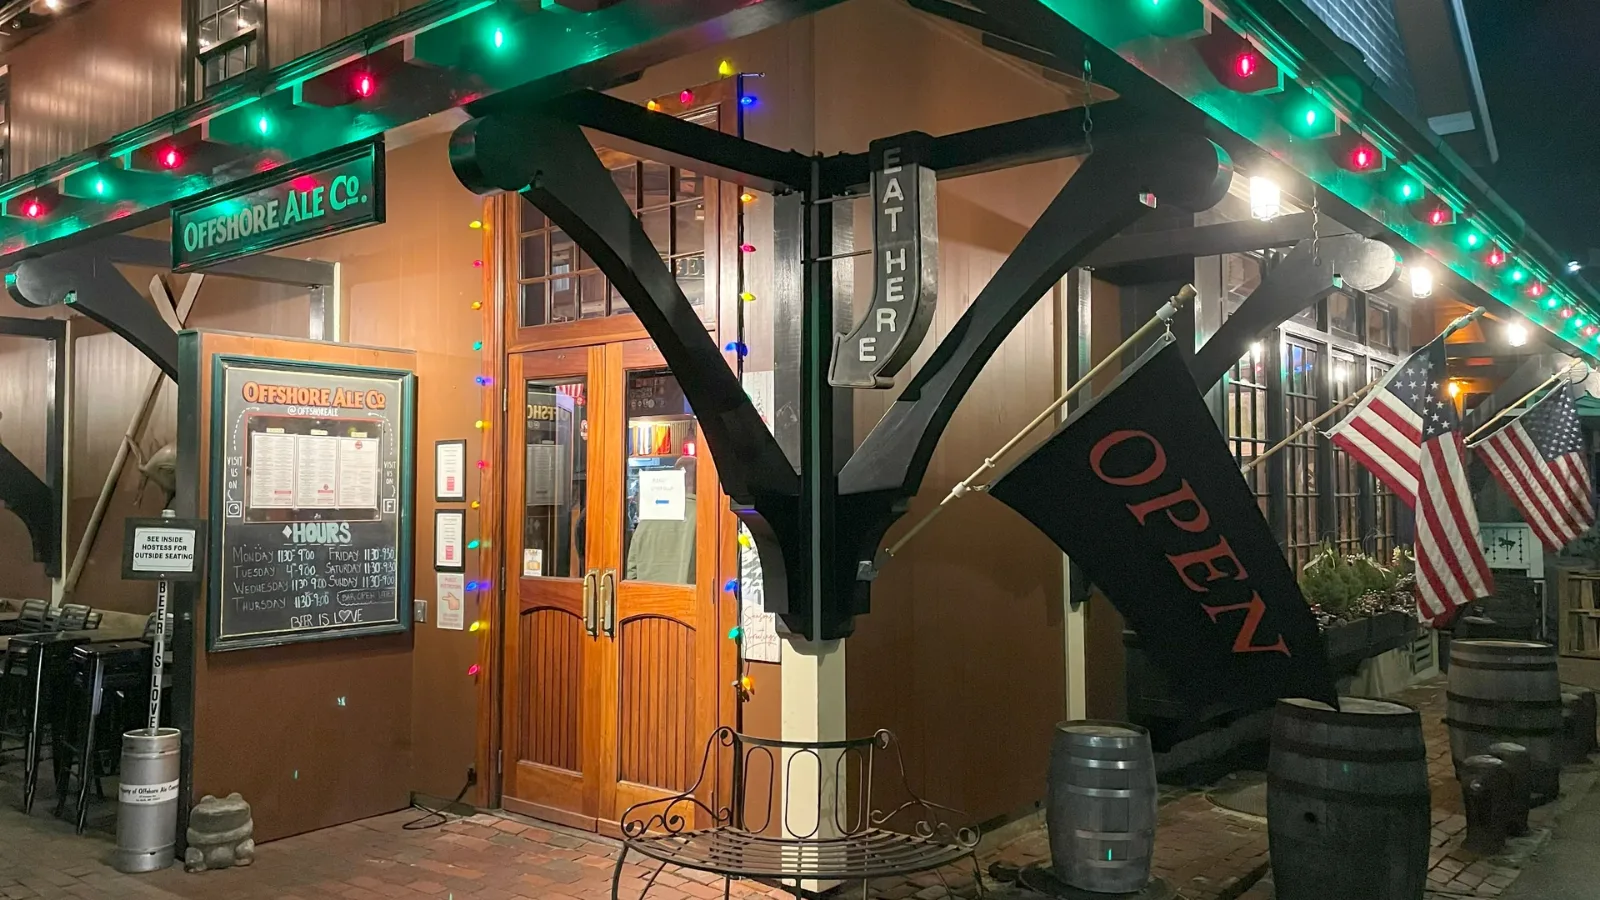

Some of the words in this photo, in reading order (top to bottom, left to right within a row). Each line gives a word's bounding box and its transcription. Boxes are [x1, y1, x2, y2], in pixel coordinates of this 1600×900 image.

[882, 147, 905, 233] EAT
[184, 200, 280, 252] OFFSHORE
[283, 186, 325, 226] ALE
[858, 248, 907, 362] HERE
[242, 381, 332, 407] OFFSHORE
[332, 387, 363, 409] ALE
[226, 456, 243, 467] VISIT
[228, 480, 238, 489] ON
[292, 522, 352, 544] HOURS
[1089, 429, 1292, 658] OPEN
[231, 546, 274, 564] MONDAY
[328, 547, 359, 562] FRIDAY
[232, 564, 275, 579] TUESDAY
[325, 562, 362, 574] SATURDAY
[233, 580, 289, 595] WEDNESDAY
[327, 575, 358, 588] SUNDAY
[156, 581, 166, 634] BEER
[231, 596, 286, 614] THURSDAY
[290, 613, 313, 629] BEER
[318, 612, 330, 626] IS
[154, 641, 162, 668] IS
[150, 675, 160, 729] LOVE
